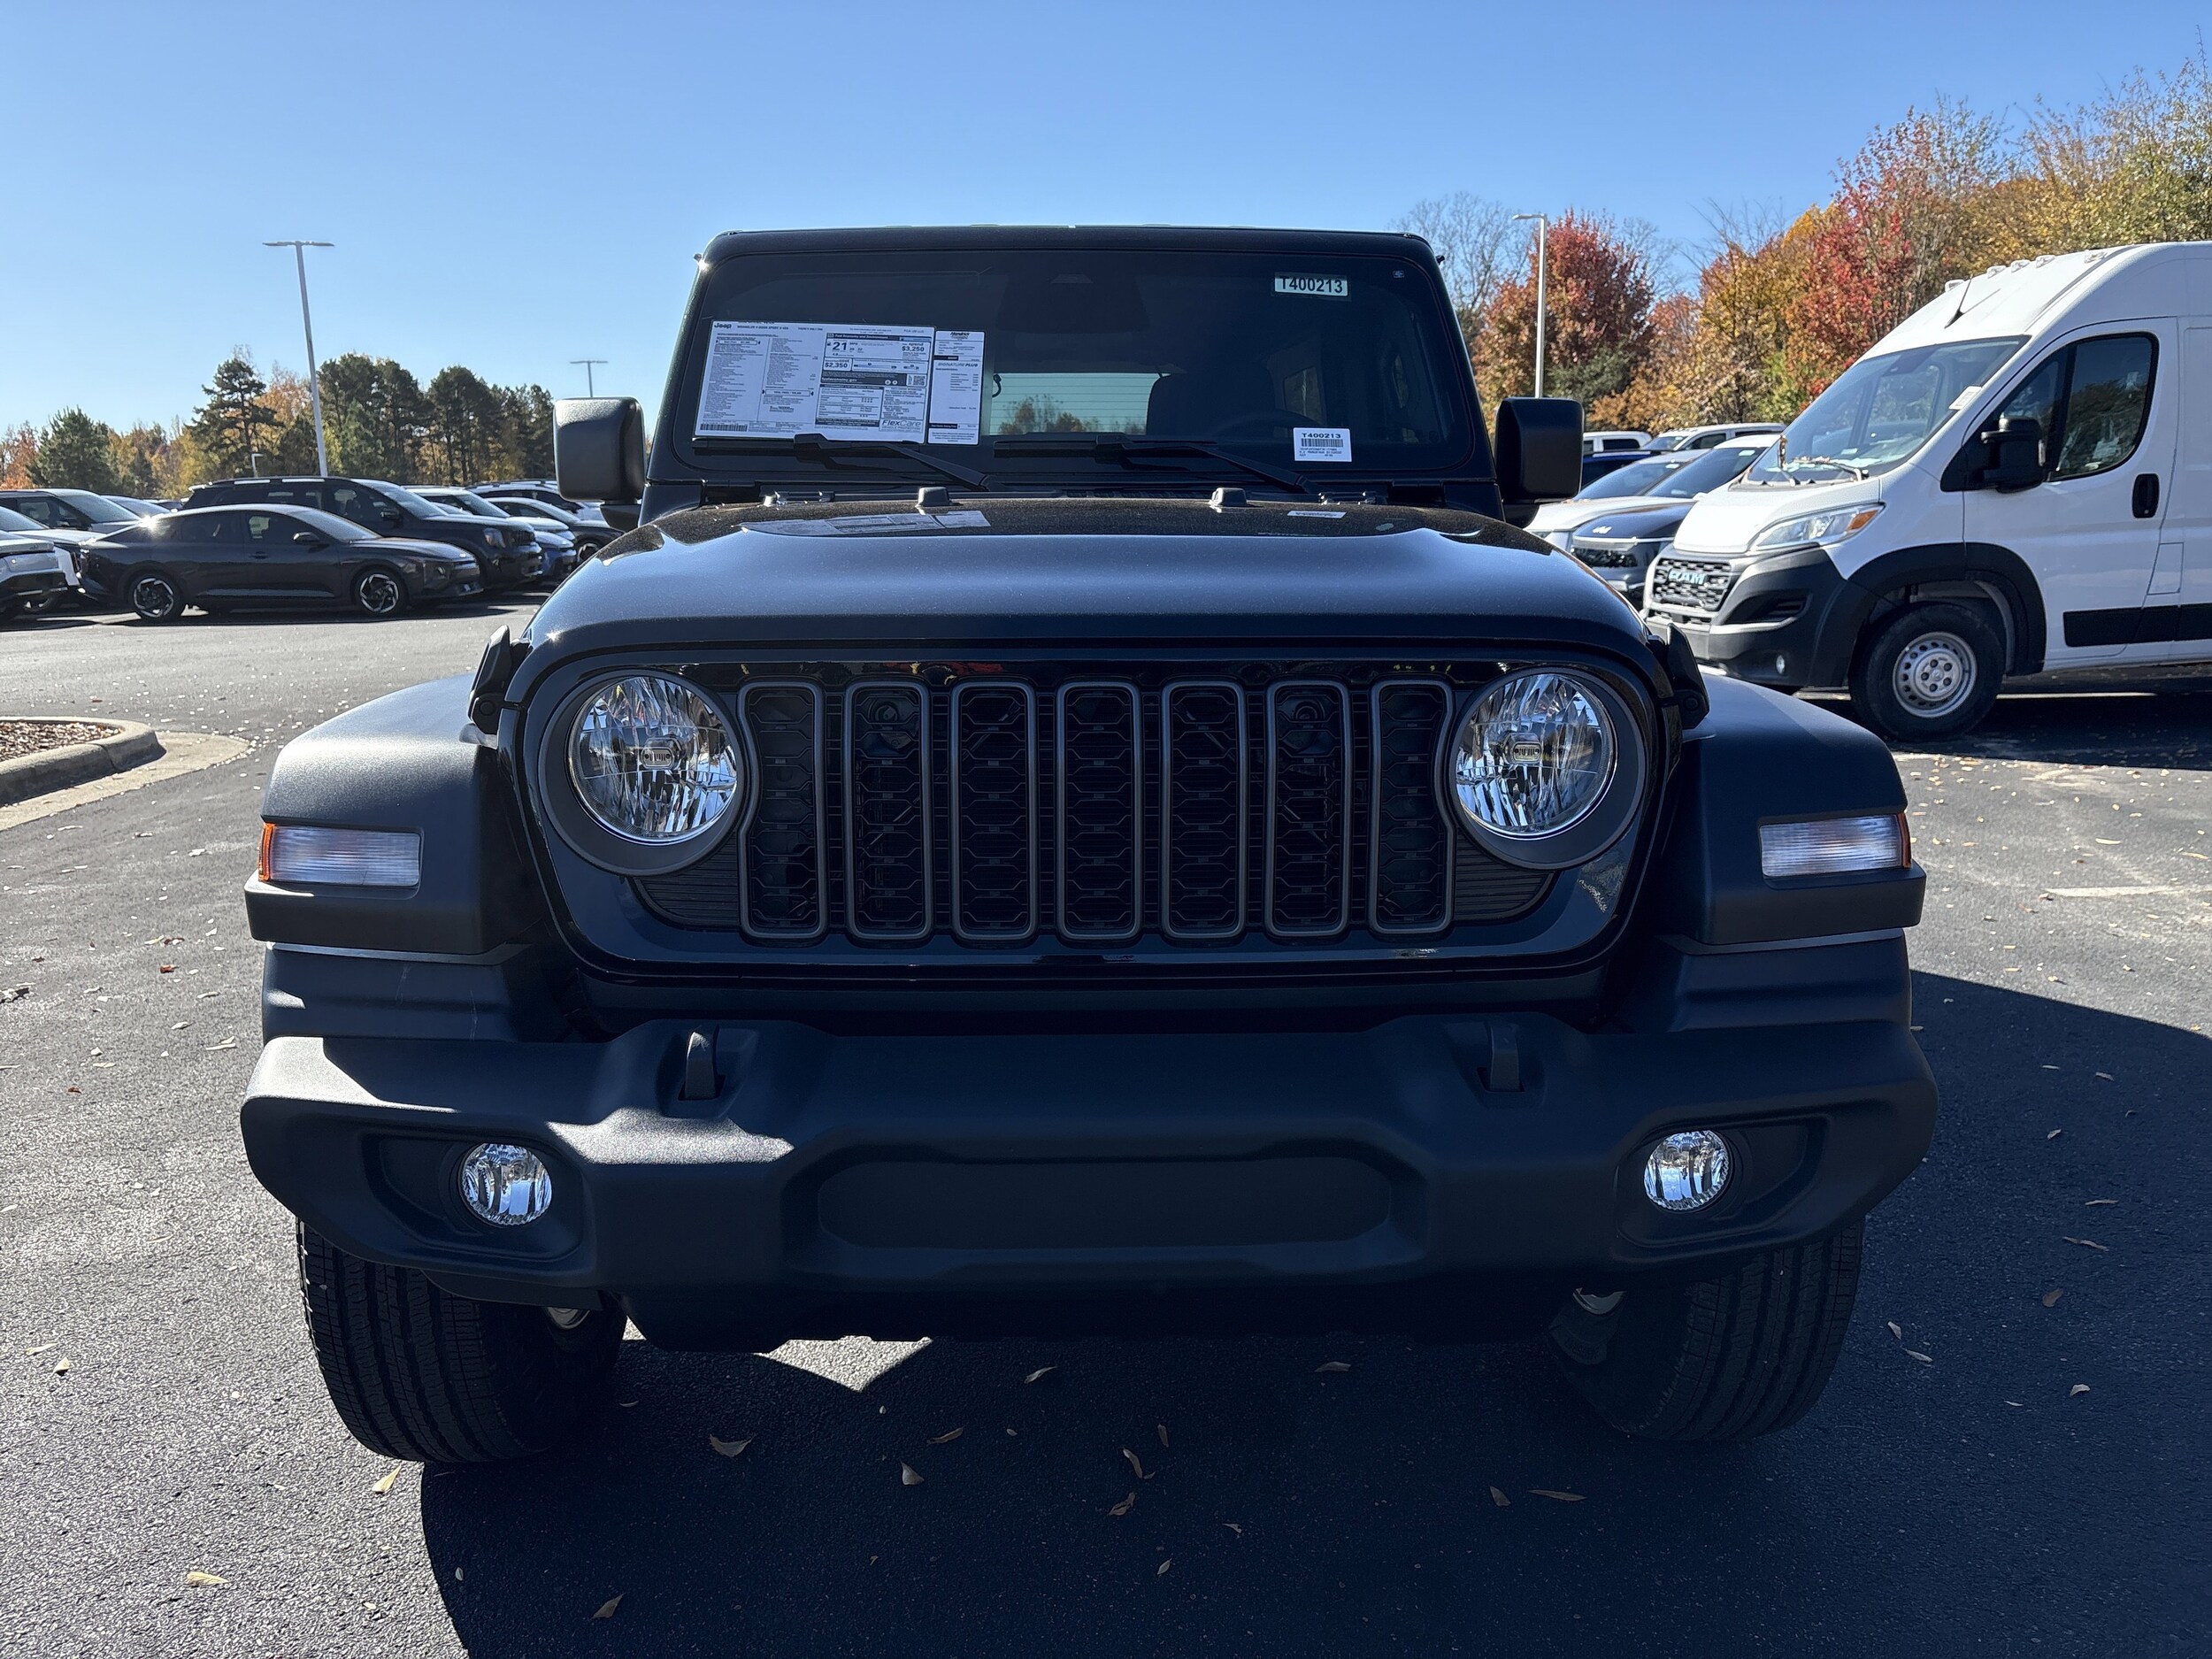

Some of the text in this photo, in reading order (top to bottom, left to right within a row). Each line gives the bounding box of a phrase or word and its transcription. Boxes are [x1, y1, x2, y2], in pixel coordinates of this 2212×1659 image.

[1279, 276, 1343, 294] T400213
[833, 342, 847, 351] 21
[1669, 570, 1705, 585] RAM
